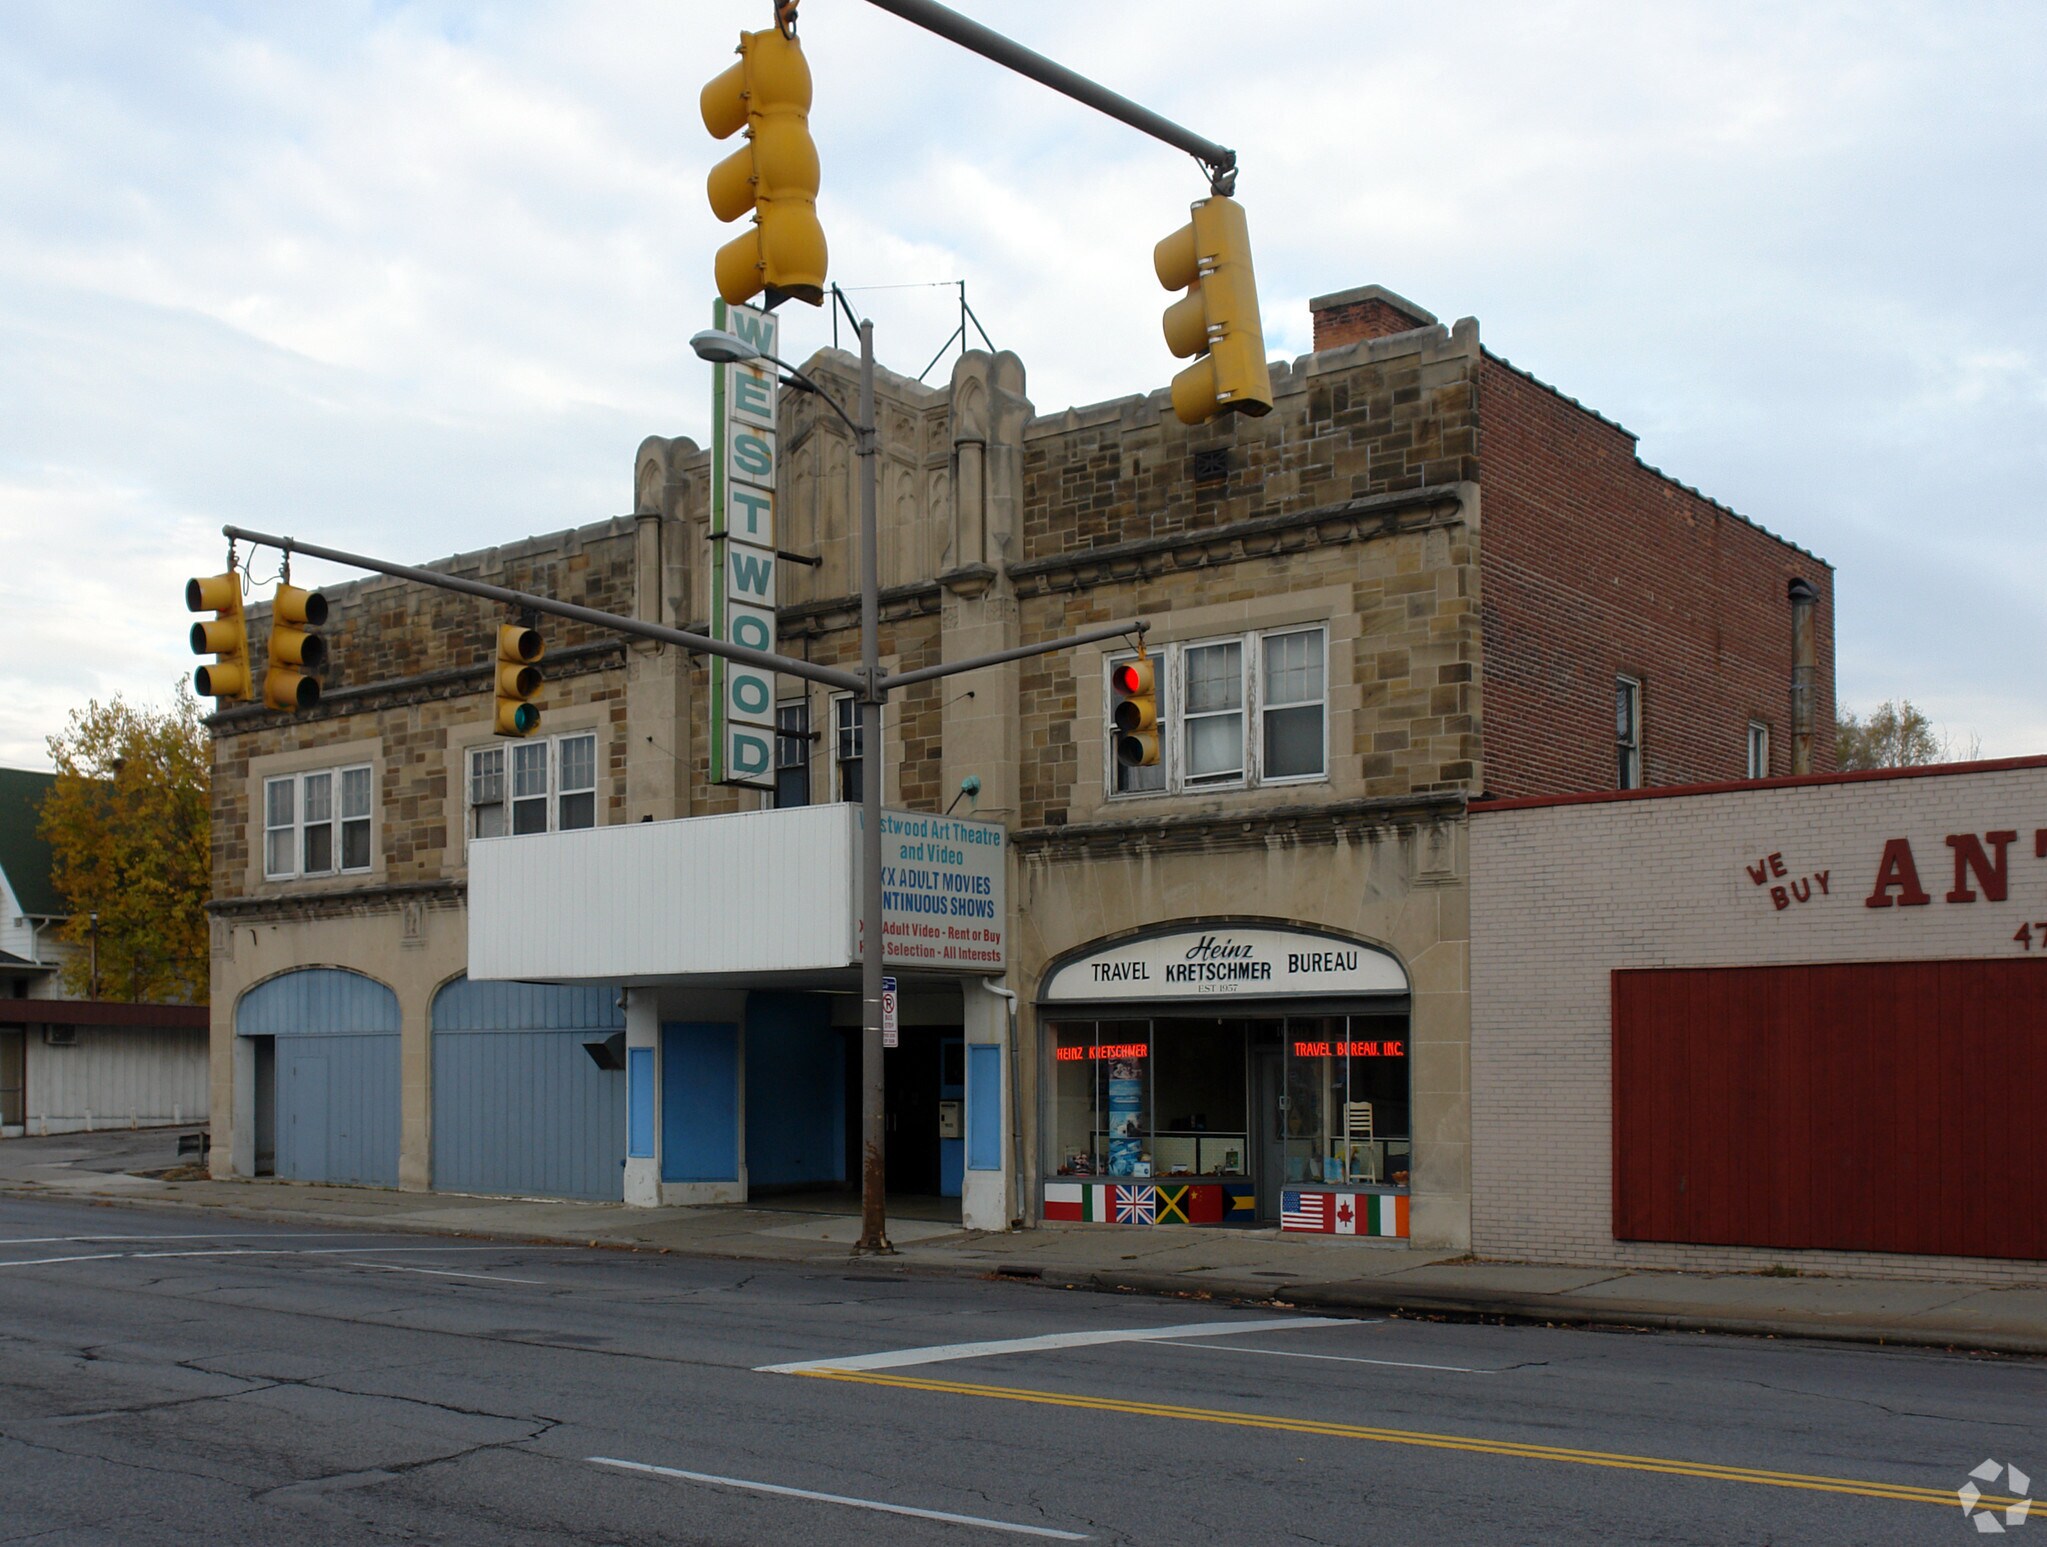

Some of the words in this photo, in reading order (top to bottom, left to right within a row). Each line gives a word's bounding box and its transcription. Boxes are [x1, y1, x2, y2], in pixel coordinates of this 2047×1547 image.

[731, 310, 775, 775] WESTWOOD
[859, 811, 928, 838] stwood
[931, 820, 950, 840] Art
[953, 823, 1001, 847] Theatre
[900, 842, 924, 862] and
[927, 844, 964, 866] Video
[899, 868, 940, 891] ADULT
[942, 871, 991, 895] MOVIES
[1746, 851, 1788, 886] WE
[1865, 828, 2047, 909] AN
[1770, 869, 1830, 911] BUY
[882, 891, 948, 915] NTINUOUS
[950, 896, 995, 919] SHOWS
[882, 921, 910, 936] Adult
[911, 923, 940, 938] Video
[948, 926, 970, 942] Rent
[972, 930, 982, 942] or
[983, 928, 1001, 945] Buy
[887, 941, 936, 959] Selection
[944, 946, 956, 959] All
[958, 947, 1001, 962] Interests
[1186, 935, 1254, 961] Heinz
[1091, 961, 1150, 983] TRAVEL
[1165, 961, 1272, 983] KRETSCHMER
[1287, 951, 1358, 974] BUREAU
[1198, 984, 1216, 993] EST
[1219, 983, 1239, 993] 1957
[1056, 1046, 1083, 1060] HEINZ
[1088, 1043, 1148, 1060] KRETSCHMER
[1294, 1041, 1332, 1056] TRAVEL
